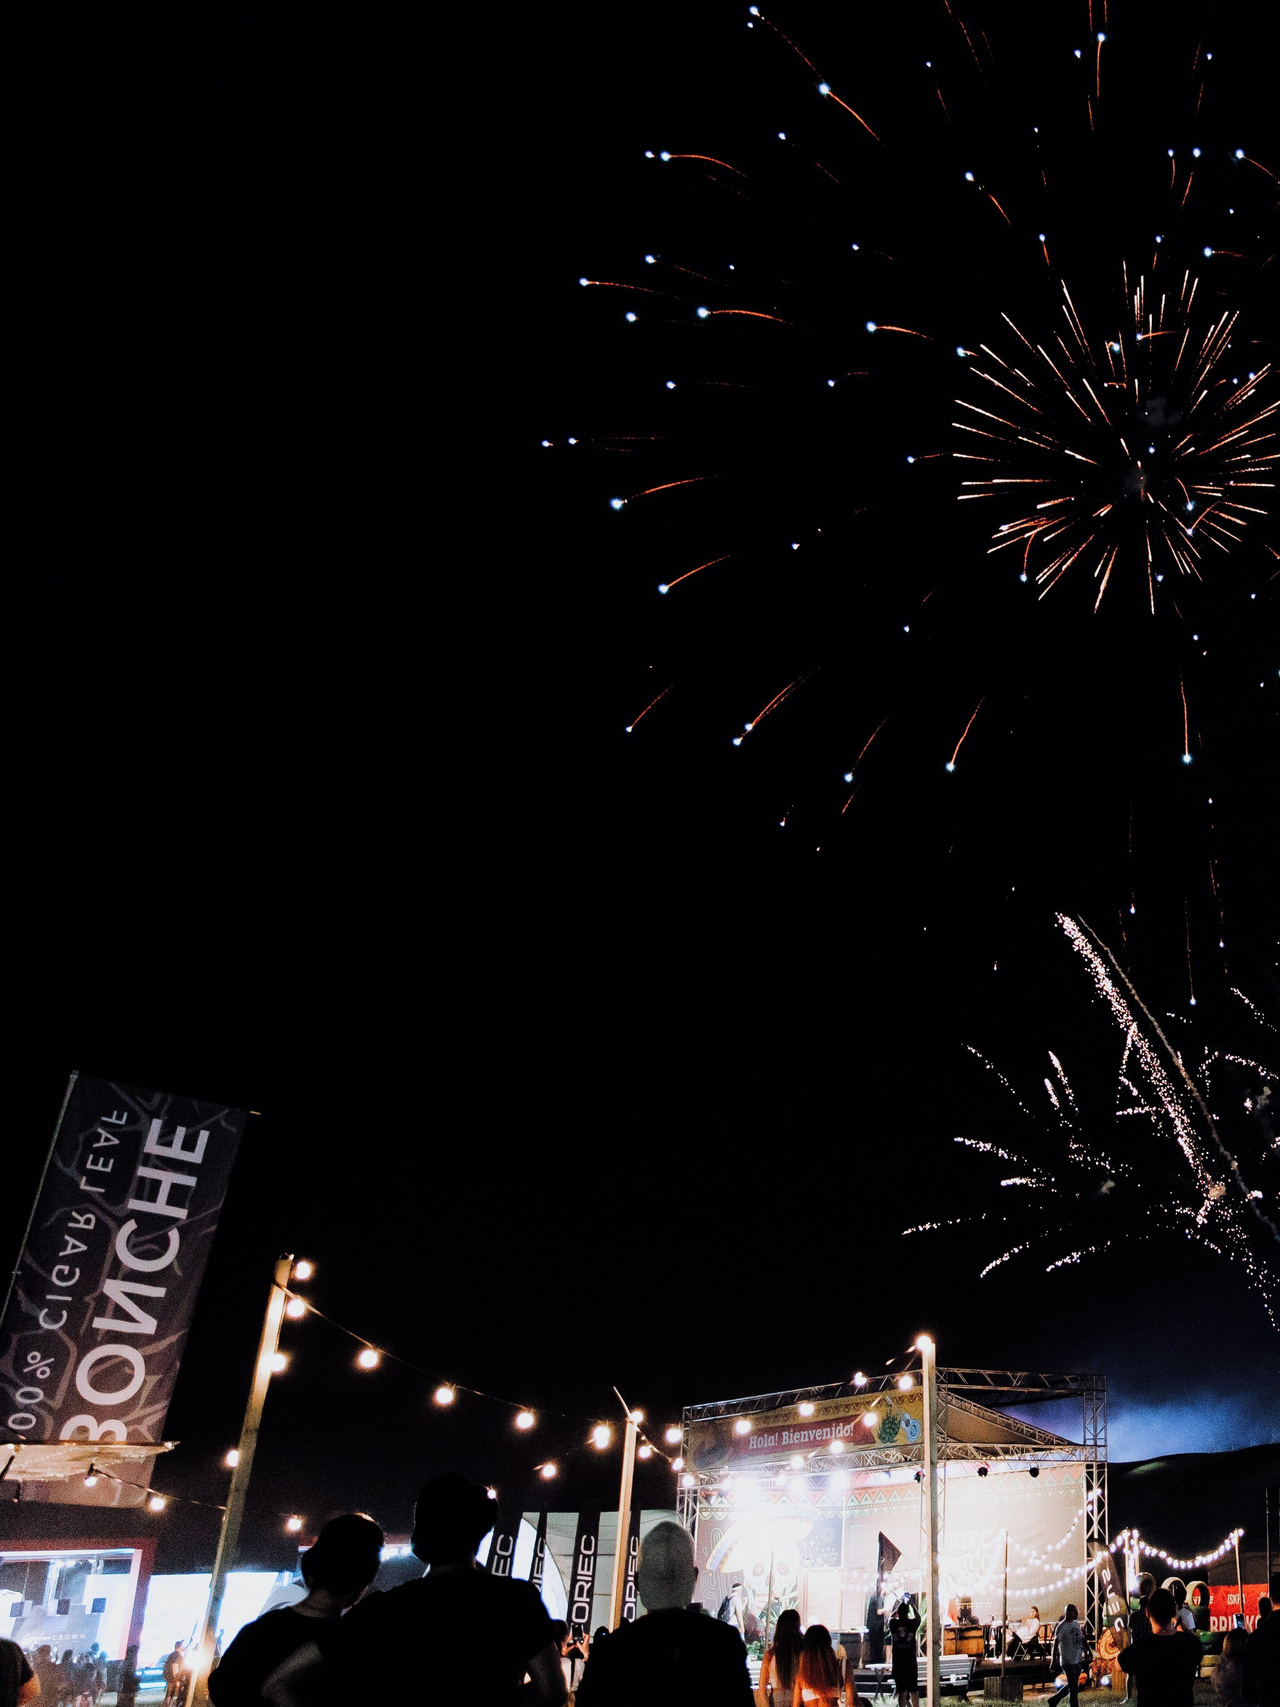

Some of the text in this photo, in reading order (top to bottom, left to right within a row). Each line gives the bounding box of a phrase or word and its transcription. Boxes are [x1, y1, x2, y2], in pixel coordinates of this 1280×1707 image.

[749, 1422, 854, 1449] Hola! Bienvenido!
[571, 1534, 596, 1624] ORIEC
[623, 1535, 640, 1623] ORIEC
[52, 1633, 86, 1641] CROWN
